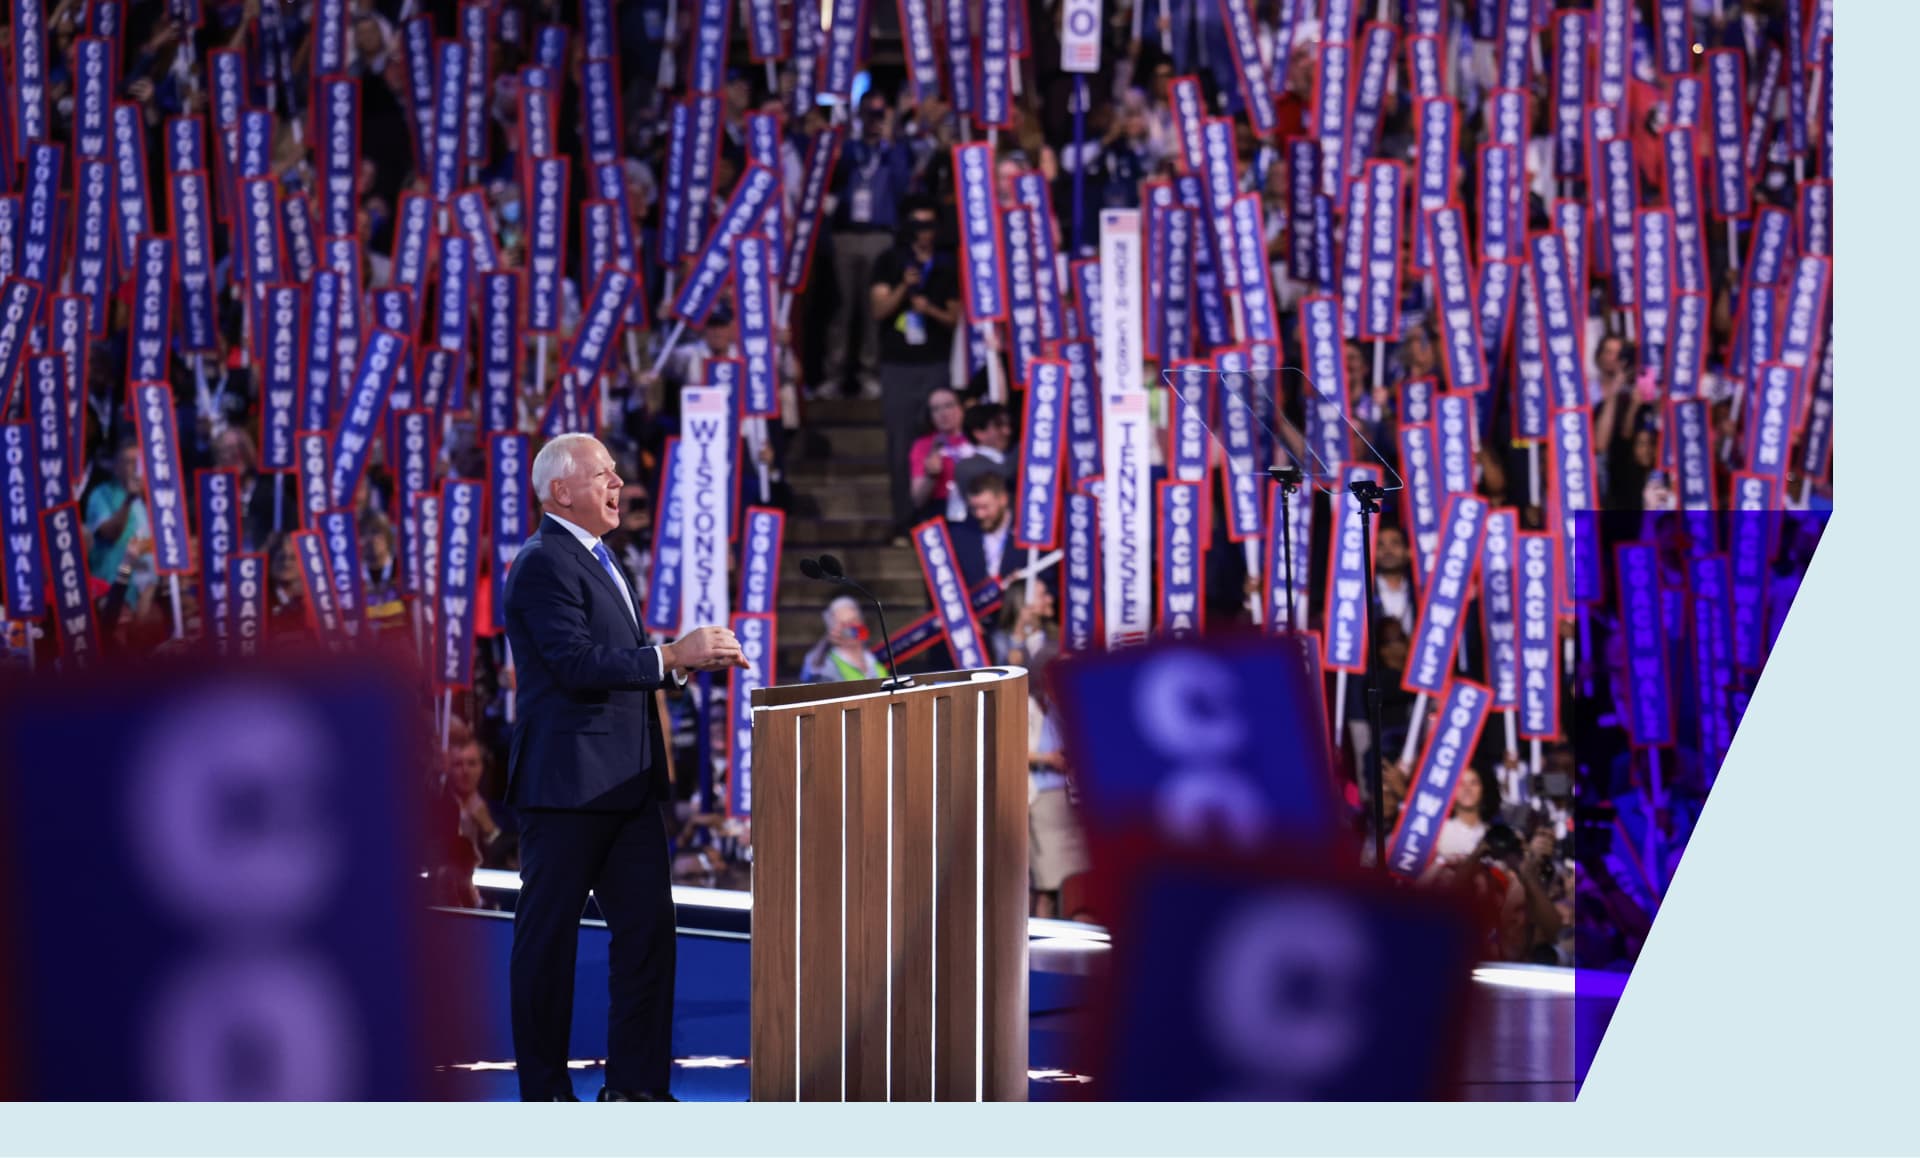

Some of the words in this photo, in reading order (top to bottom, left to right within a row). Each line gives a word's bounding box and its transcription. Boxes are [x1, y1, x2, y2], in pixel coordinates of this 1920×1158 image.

[1361, 28, 1387, 104] COACH
[1562, 14, 1581, 97] COACH
[1662, 5, 1683, 72] WALZ
[21, 86, 41, 137] WAL
[85, 42, 102, 128] COACH
[219, 53, 237, 123] COAC
[333, 81, 349, 168] COACH
[441, 44, 462, 127] COACH
[589, 64, 610, 143] COACH
[1178, 80, 1202, 165] COACH
[1325, 46, 1344, 130] COACH
[1716, 52, 1736, 137] COACH
[115, 106, 137, 191] COACH
[177, 121, 193, 170] COA
[438, 136, 458, 200] WALZ
[694, 97, 713, 178] COACH
[755, 116, 772, 165] COA
[1207, 122, 1231, 209] COACH
[1321, 137, 1341, 195] WALZ
[1424, 102, 1446, 188] COACH
[1671, 130, 1692, 217] COACH
[1719, 145, 1740, 212] WALZ
[31, 146, 51, 235] COACH
[85, 163, 104, 251] COACH
[181, 174, 202, 265] COACH
[251, 180, 273, 273] COACH
[540, 159, 558, 246] COACH
[687, 187, 707, 252] WALZ
[718, 170, 772, 246] COACH
[964, 146, 988, 235] COACH
[1374, 164, 1394, 254] COACH
[1487, 148, 1504, 234] COACH
[1610, 141, 1632, 226] COACH
[24, 244, 45, 280] WA
[401, 195, 425, 282] COACH
[970, 243, 995, 313] WALZ
[1009, 209, 1032, 299] COACH
[1169, 209, 1187, 299] COACH
[1234, 199, 1260, 282] COACH
[1438, 209, 1465, 300] COACH
[1539, 235, 1568, 327] COACH
[1612, 234, 1634, 302] WALZ
[1645, 212, 1664, 301] COACH
[1756, 211, 1783, 282] COAC
[144, 241, 164, 330] COACH
[183, 273, 206, 346] WALZ
[312, 273, 333, 361] COACH
[444, 239, 462, 326] COACH
[491, 275, 509, 361] COACH
[534, 257, 555, 327] WALZ
[682, 252, 727, 316] WALZ
[741, 238, 763, 328] COACH
[1244, 290, 1265, 341] WAL
[1370, 262, 1393, 331] WALZ
[1789, 258, 1819, 343] COACH
[139, 340, 161, 380] WA
[275, 289, 294, 382] COACH
[745, 337, 767, 410] WALZ
[1166, 310, 1188, 361] WAL
[1312, 302, 1337, 394] COACH
[1448, 310, 1475, 383] WALZ
[1550, 336, 1577, 407] WALZ
[1676, 297, 1698, 385] COACH
[38, 356, 58, 450] COACH
[353, 333, 396, 425] COACH
[1031, 364, 1057, 459] COACH
[1066, 342, 1091, 434] COACH
[1182, 364, 1202, 458] COACH
[1221, 353, 1248, 447] COACH
[1519, 361, 1543, 435] WALZ
[1759, 369, 1789, 466] COACH
[146, 386, 170, 480] COACH
[271, 391, 294, 464] WALZ
[331, 432, 366, 504] WALZ
[1072, 441, 1096, 477] WA
[1444, 398, 1465, 492] COACH
[1562, 413, 1585, 510] COACH
[1682, 404, 1704, 494] COACH
[5, 425, 27, 524] COACH
[305, 436, 325, 512] COAC
[501, 435, 520, 534] COACH
[1027, 466, 1053, 540] WALZ
[1230, 455, 1257, 530] WALZ
[1408, 429, 1436, 525] COACH
[53, 511, 80, 607] COACH
[154, 490, 179, 565] WALZ
[210, 474, 229, 572] COACH
[328, 514, 355, 610] COACH
[447, 483, 470, 587] COACH
[690, 420, 718, 623] WISCONSIN
[746, 513, 770, 613] COACH
[1070, 495, 1088, 580] COACH
[1120, 423, 1136, 624] TENNESSEE
[1171, 486, 1191, 584] COACH
[1439, 498, 1479, 598] COACH
[1487, 514, 1511, 611] COACH
[1741, 478, 1762, 576] COACH
[10, 535, 32, 612] WALZ
[657, 550, 680, 624] WALZ
[923, 527, 965, 622] COACH
[1526, 538, 1545, 640] COACH
[1627, 547, 1654, 648] COACH
[444, 596, 467, 679] WALZ
[1069, 587, 1090, 650] WALZ
[1336, 579, 1362, 661] WALZ
[1418, 604, 1457, 686] WALZ
[1523, 648, 1548, 730] WALZ
[1428, 687, 1478, 788] COACH
[1398, 791, 1442, 870] WALZ
